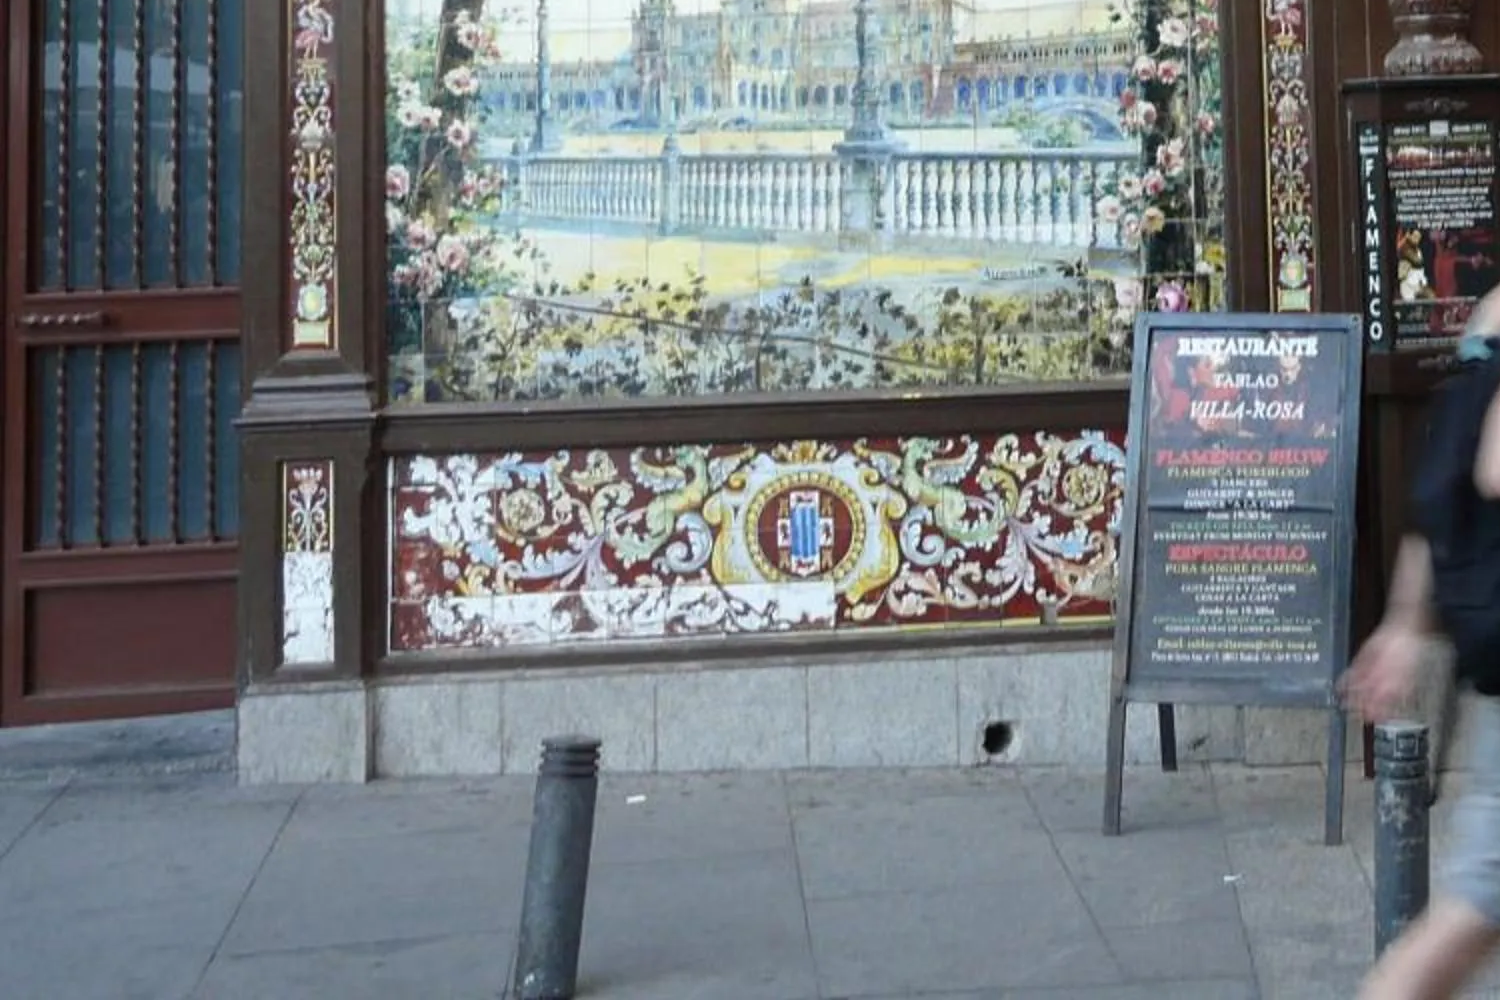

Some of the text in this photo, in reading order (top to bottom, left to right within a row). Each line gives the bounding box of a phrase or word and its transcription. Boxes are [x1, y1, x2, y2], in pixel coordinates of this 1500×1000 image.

[1364, 158, 1384, 341] FLAMENCO
[1176, 336, 1319, 356] RESTAURANTE
[1214, 372, 1279, 388] TABLAO
[1189, 400, 1305, 421] VILLA-ROSA
[1156, 448, 1264, 467] FLAMENCO
